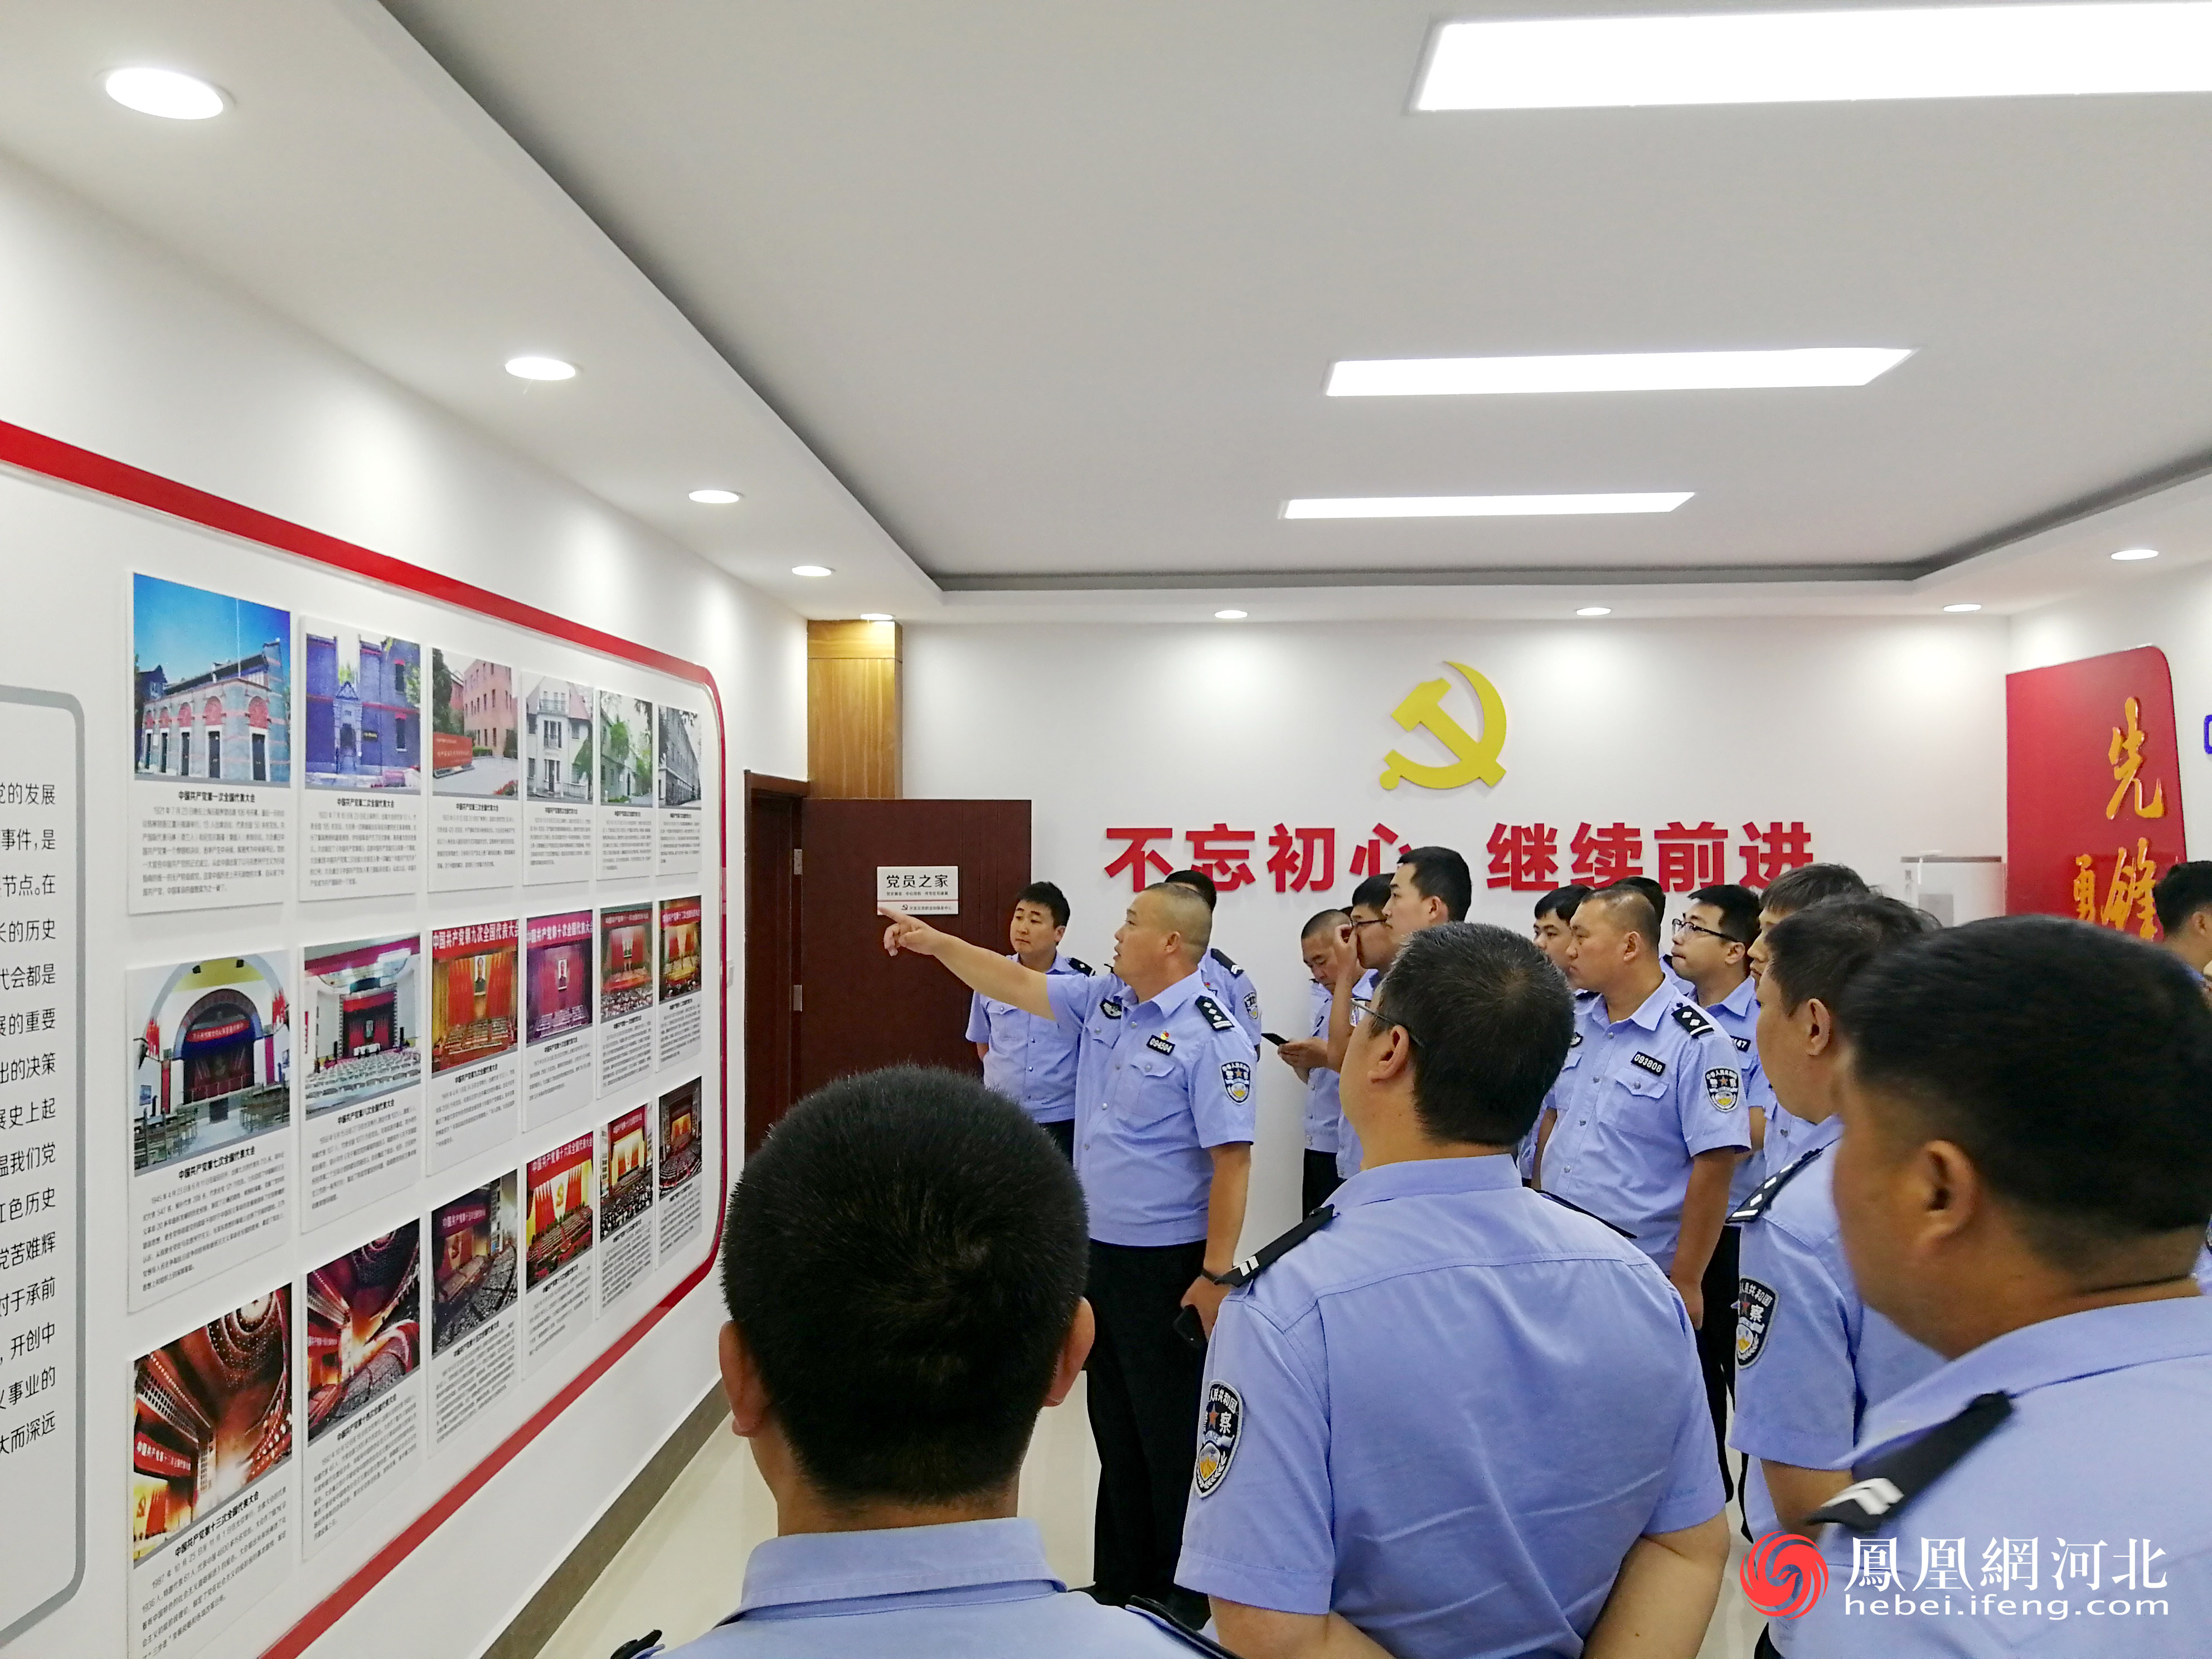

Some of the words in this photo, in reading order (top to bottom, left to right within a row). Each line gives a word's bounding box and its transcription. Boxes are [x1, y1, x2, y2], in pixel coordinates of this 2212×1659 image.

[178, 790, 256, 803] 中国共产党第一次全国代表大会
[1486, 821, 1814, 892] 继续前进
[886, 874, 948, 888] 党员之家
[433, 919, 519, 950] 中国共产党第九次全国代表大会
[1634, 1054, 1662, 1073] 093808
[178, 1146, 255, 1180] 中国共产党第七次全国代表大会
[1750, 1304, 1764, 1322] 察
[1219, 1411, 1232, 1434] 察
[174, 1491, 259, 1557] 中国共产党第十三次全国代表大会
